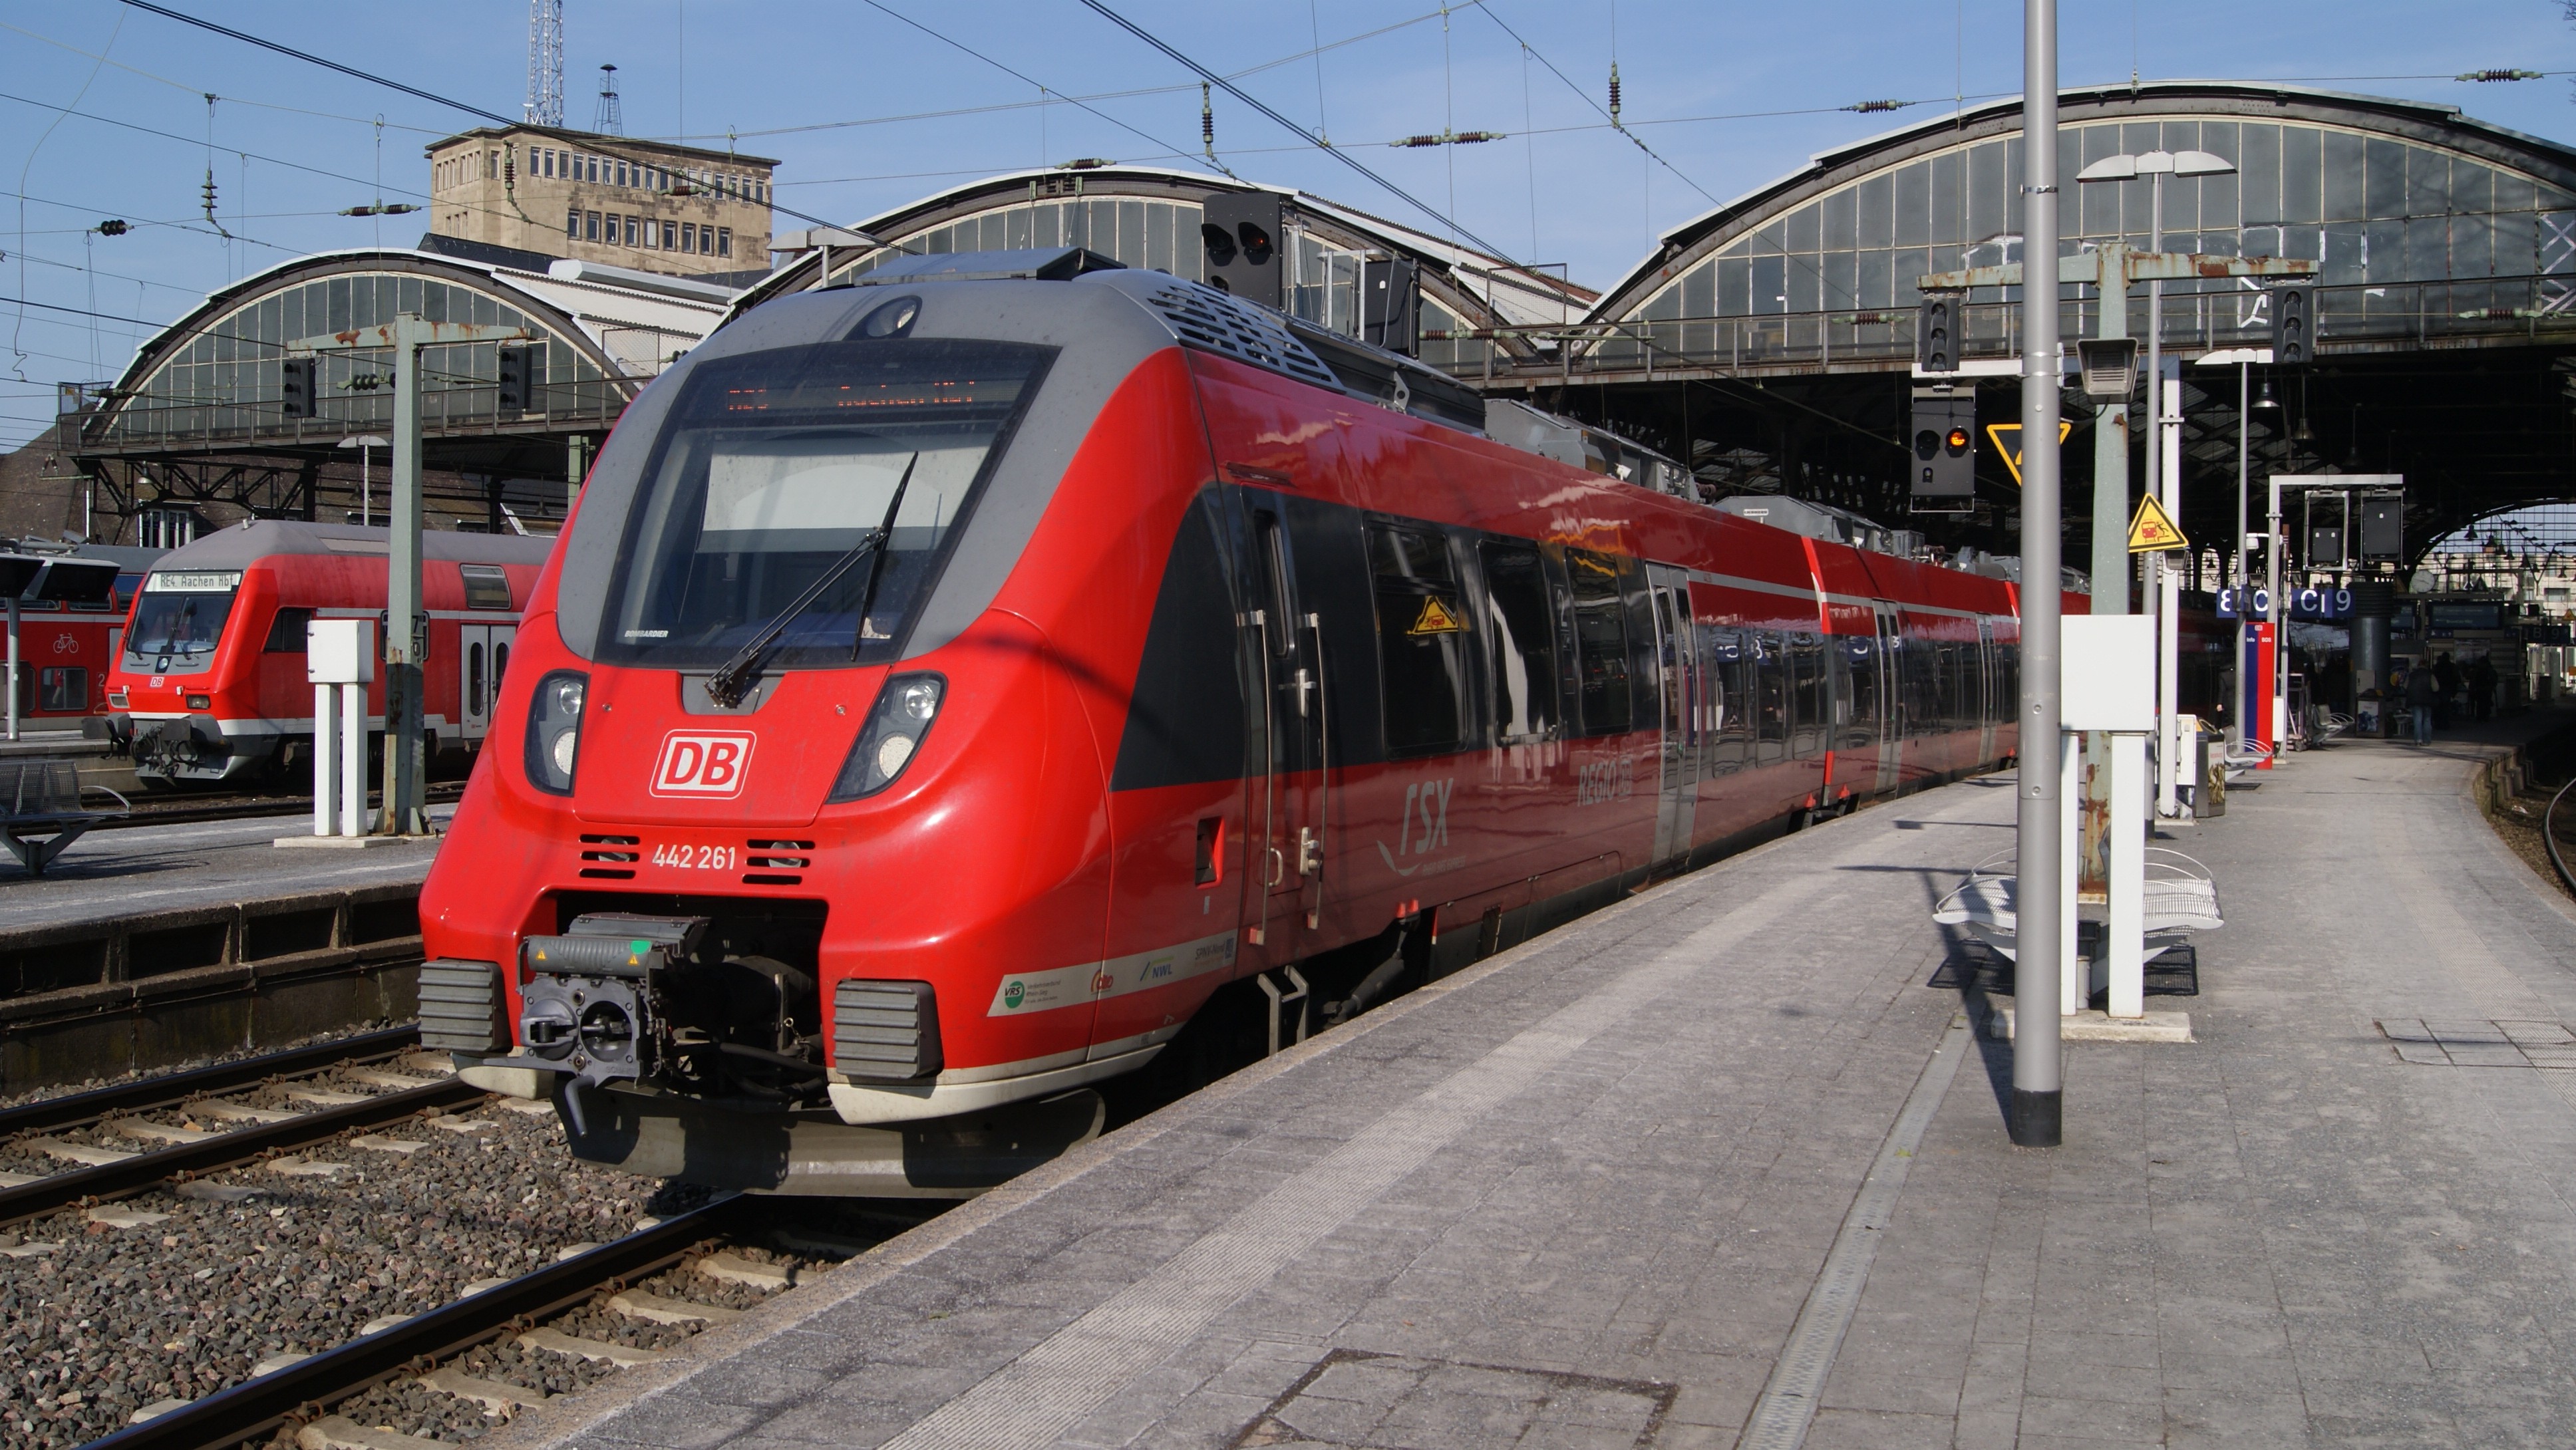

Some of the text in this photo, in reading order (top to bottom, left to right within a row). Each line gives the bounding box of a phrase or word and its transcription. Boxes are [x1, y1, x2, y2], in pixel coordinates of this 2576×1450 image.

[181, 574, 214, 587] Aachen
[218, 573, 233, 587] Hbf
[2335, 589, 2351, 611] 9
[1557, 589, 1568, 627] 2
[2551, 628, 2560, 639] 9
[98, 673, 105, 687] 2
[151, 677, 163, 686] DB
[662, 740, 740, 786] DB
[1577, 760, 1617, 807] REGIO
[652, 843, 736, 870] 442 261
[1152, 964, 1173, 979] NWL
[1005, 986, 1021, 997] VRS
